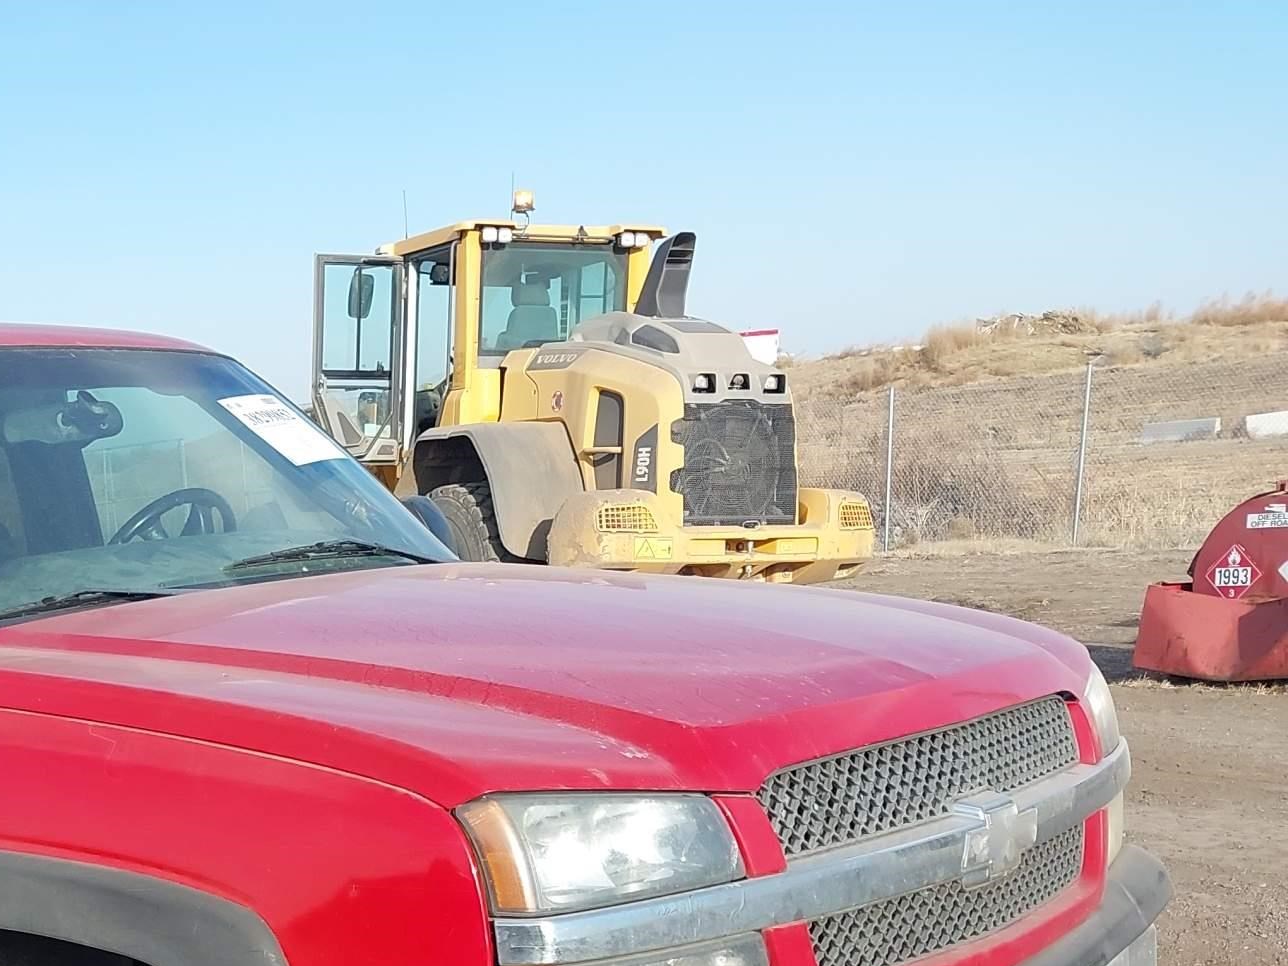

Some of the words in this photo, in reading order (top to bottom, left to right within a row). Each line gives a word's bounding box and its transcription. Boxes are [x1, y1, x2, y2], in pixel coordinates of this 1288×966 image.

[536, 353, 578, 364] VOLVO
[635, 447, 652, 482] L90H
[1257, 513, 1288, 521] DIESEL
[1251, 520, 1270, 528] OFF
[1217, 569, 1249, 586] 1993
[1228, 588, 1235, 598] 3
